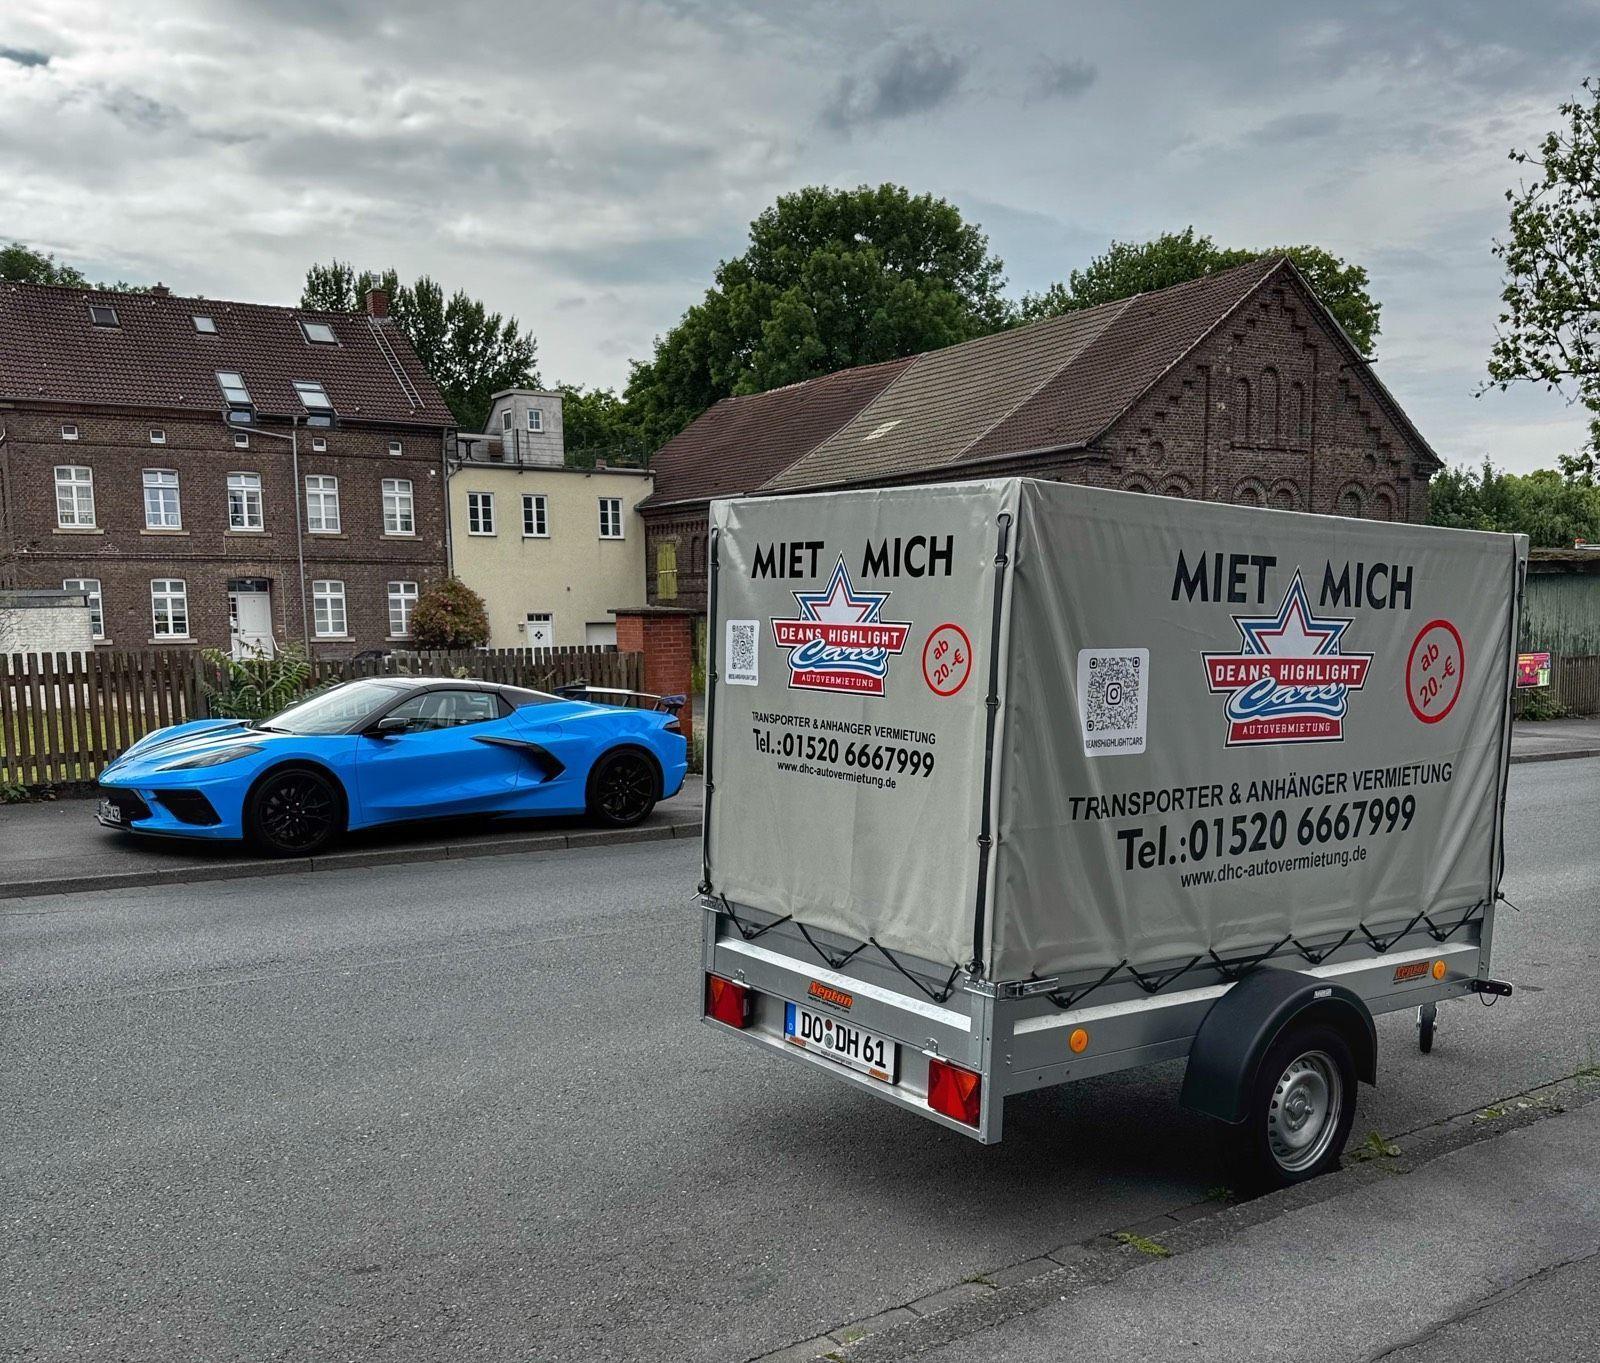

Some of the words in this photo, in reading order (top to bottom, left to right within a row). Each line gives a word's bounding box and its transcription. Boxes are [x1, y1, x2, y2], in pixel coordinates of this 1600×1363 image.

[751, 541, 824, 579] MIET
[861, 535, 954, 578] MICH
[1170, 548, 1277, 604] MIET
[1319, 559, 1414, 610] MICH
[780, 627, 822, 640] DEANS
[828, 629, 900, 645] HIGHLIGHT
[933, 640, 949, 660] ab
[790, 638, 887, 668] Cars
[1420, 643, 1439, 672] ab
[801, 674, 874, 687] AUTOVERMIETUNG
[1215, 664, 1271, 682] DEANS
[1279, 664, 1361, 681] HIGHLIGHT
[1227, 676, 1346, 716] Cars
[752, 711, 811, 728] TRANSPORTER
[812, 718, 819, 729] &
[874, 725, 936, 745] VERMIETUNG
[1242, 722, 1331, 735] AUTOVERMIETUNG
[777, 761, 896, 789] www.dhc-autovermietung.de
[844, 742, 935, 778] 6667999
[1069, 784, 1224, 821] TRANSPORTER
[1229, 782, 1242, 804] &
[1246, 772, 1348, 803] ANHÄNGER
[1352, 762, 1452, 791] VERMIETUNG
[1297, 794, 1416, 846] 6667999
[1180, 845, 1367, 888] www.dhc-autovermietung.de
[808, 981, 853, 1008] Neptun
[801, 1011, 823, 1043] DO
[835, 1024, 859, 1058] DH
[863, 1035, 886, 1069] 61
